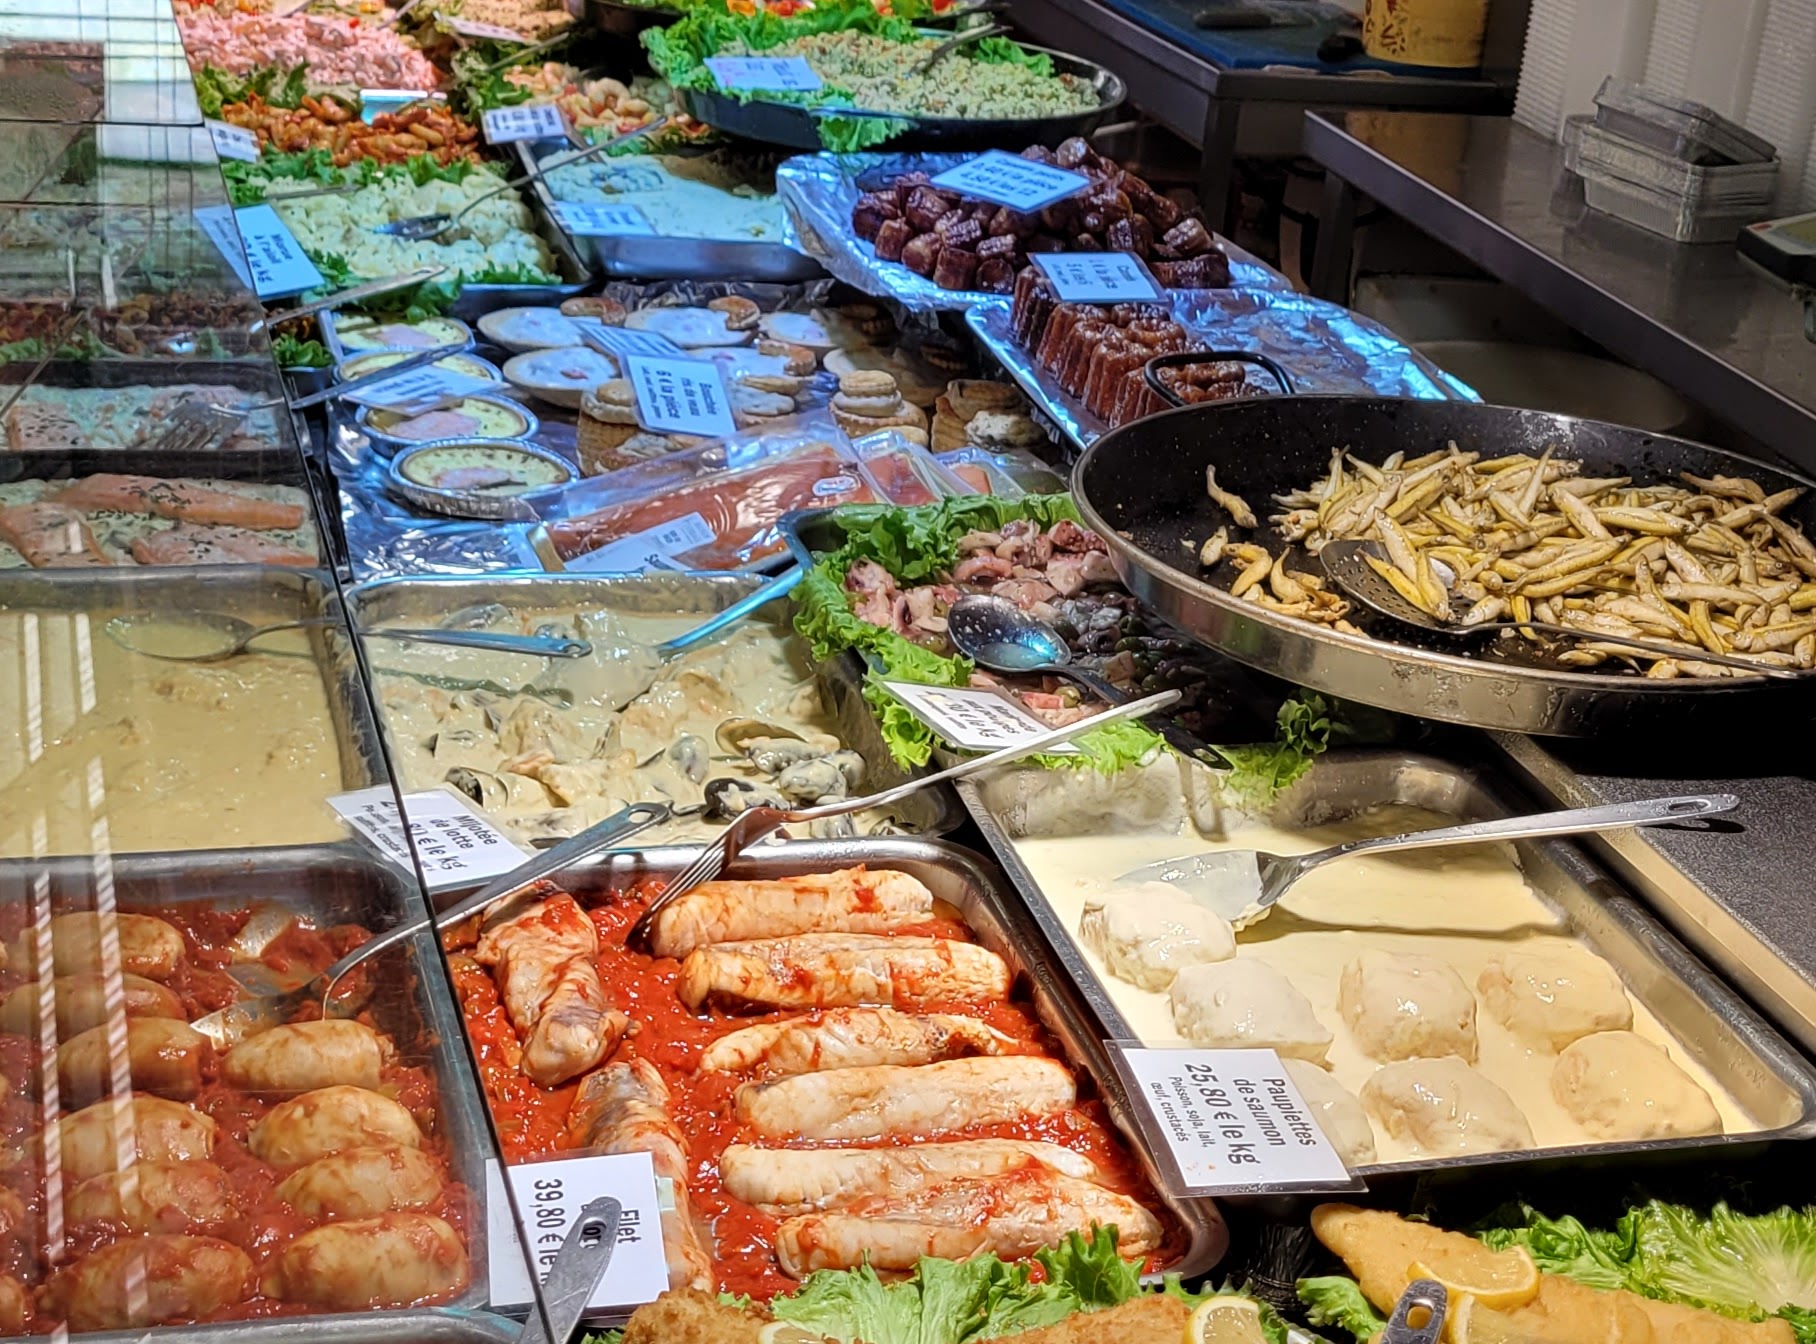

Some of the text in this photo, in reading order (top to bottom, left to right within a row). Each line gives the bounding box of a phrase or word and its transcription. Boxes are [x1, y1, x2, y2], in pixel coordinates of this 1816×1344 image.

[417, 837, 438, 846] €
[430, 818, 474, 850] de lotte
[454, 814, 499, 846] Mijotée
[424, 845, 447, 856] le
[437, 854, 468, 870] kg
[1160, 1101, 1190, 1143] crustacés
[1168, 1076, 1217, 1148] Poisson, soja, lait,
[1184, 1063, 1261, 1165] 25,80 € le kg
[1233, 1078, 1287, 1147] de saumon
[1262, 1077, 1317, 1147] Paupiettes
[528, 1178, 567, 1229] 39,80
[537, 1232, 565, 1244] €
[617, 1208, 642, 1245] Filet
